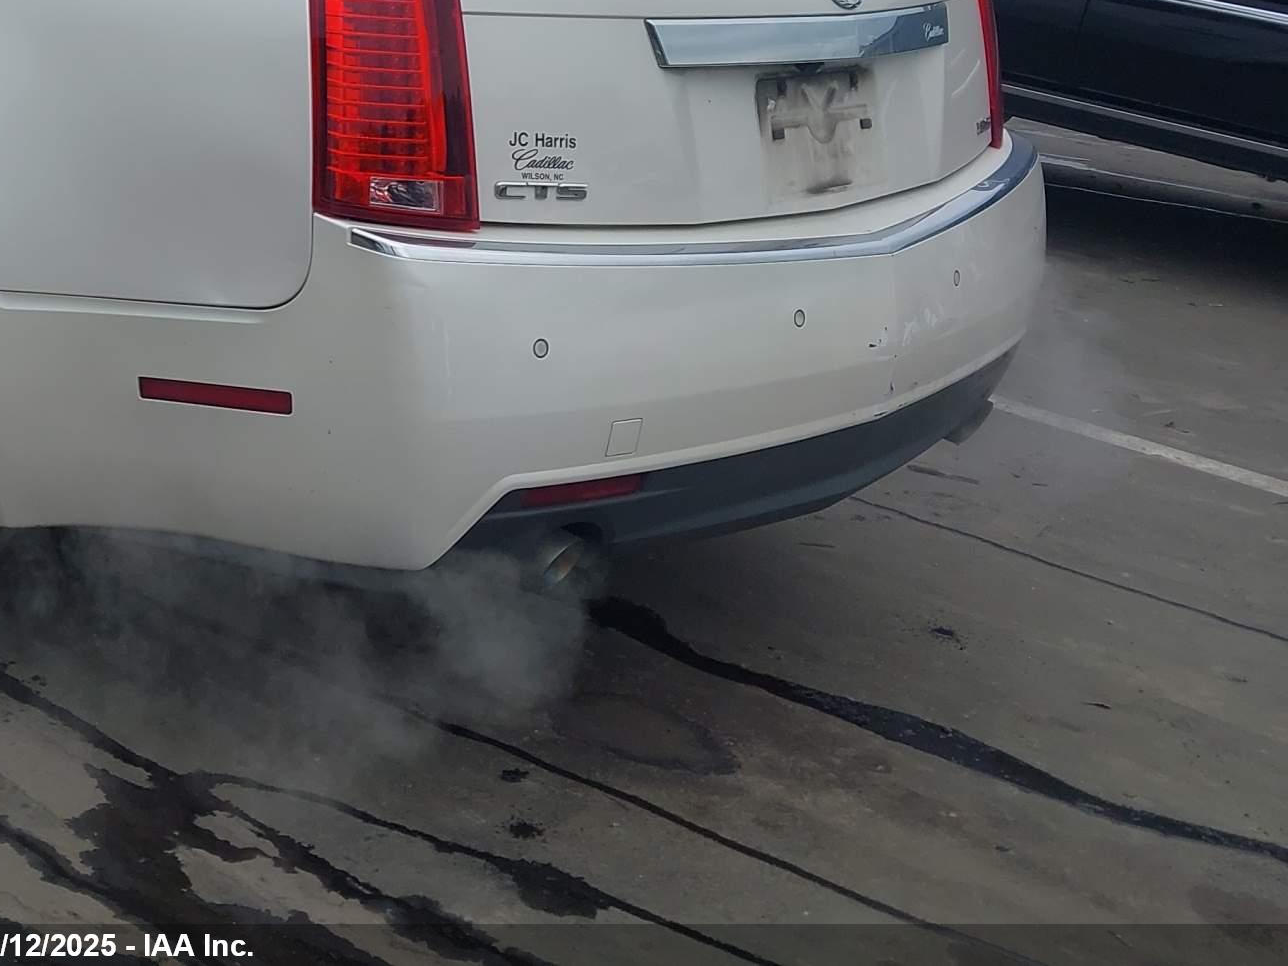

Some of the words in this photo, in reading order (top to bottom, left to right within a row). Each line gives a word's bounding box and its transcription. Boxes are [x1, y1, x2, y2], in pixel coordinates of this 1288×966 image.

[509, 132, 528, 147] JC
[535, 133, 577, 149] Harris
[512, 149, 574, 171] Cadillac
[521, 172, 552, 181] WILSON,
[553, 173, 564, 181] NC
[494, 181, 589, 201] CTS
